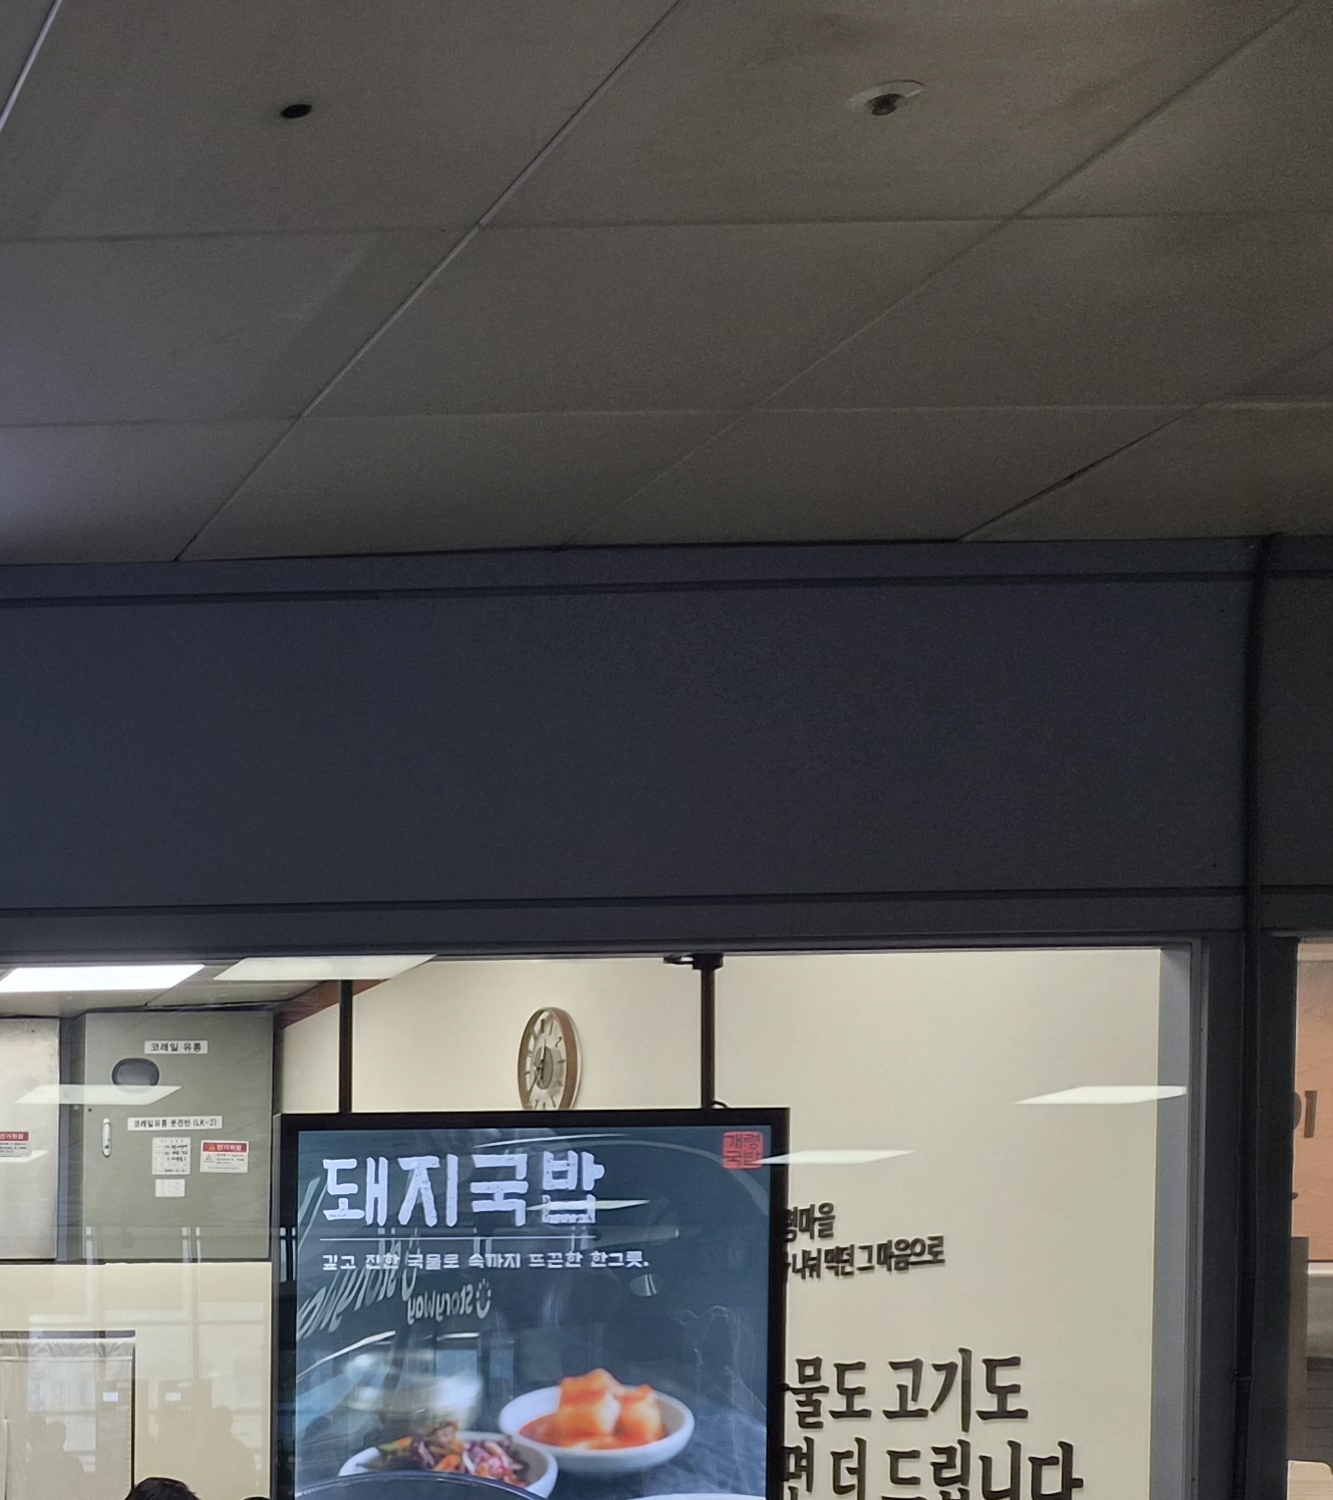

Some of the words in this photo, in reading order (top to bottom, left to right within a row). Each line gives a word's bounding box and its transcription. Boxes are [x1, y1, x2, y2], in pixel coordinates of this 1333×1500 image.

[134, 1118, 167, 1128] 코레일유통
[193, 1117, 218, 1127] (LK-2)
[322, 1150, 606, 1228] 돼지국밥
[321, 1254, 357, 1271] 깊고
[365, 1254, 401, 1271] 진한
[407, 1253, 460, 1270] 국물로
[468, 1252, 521, 1269] 속까지
[529, 1251, 584, 1269] 뜨끈한
[783, 1355, 873, 1430] 물도
[882, 1347, 1029, 1433] 고기도
